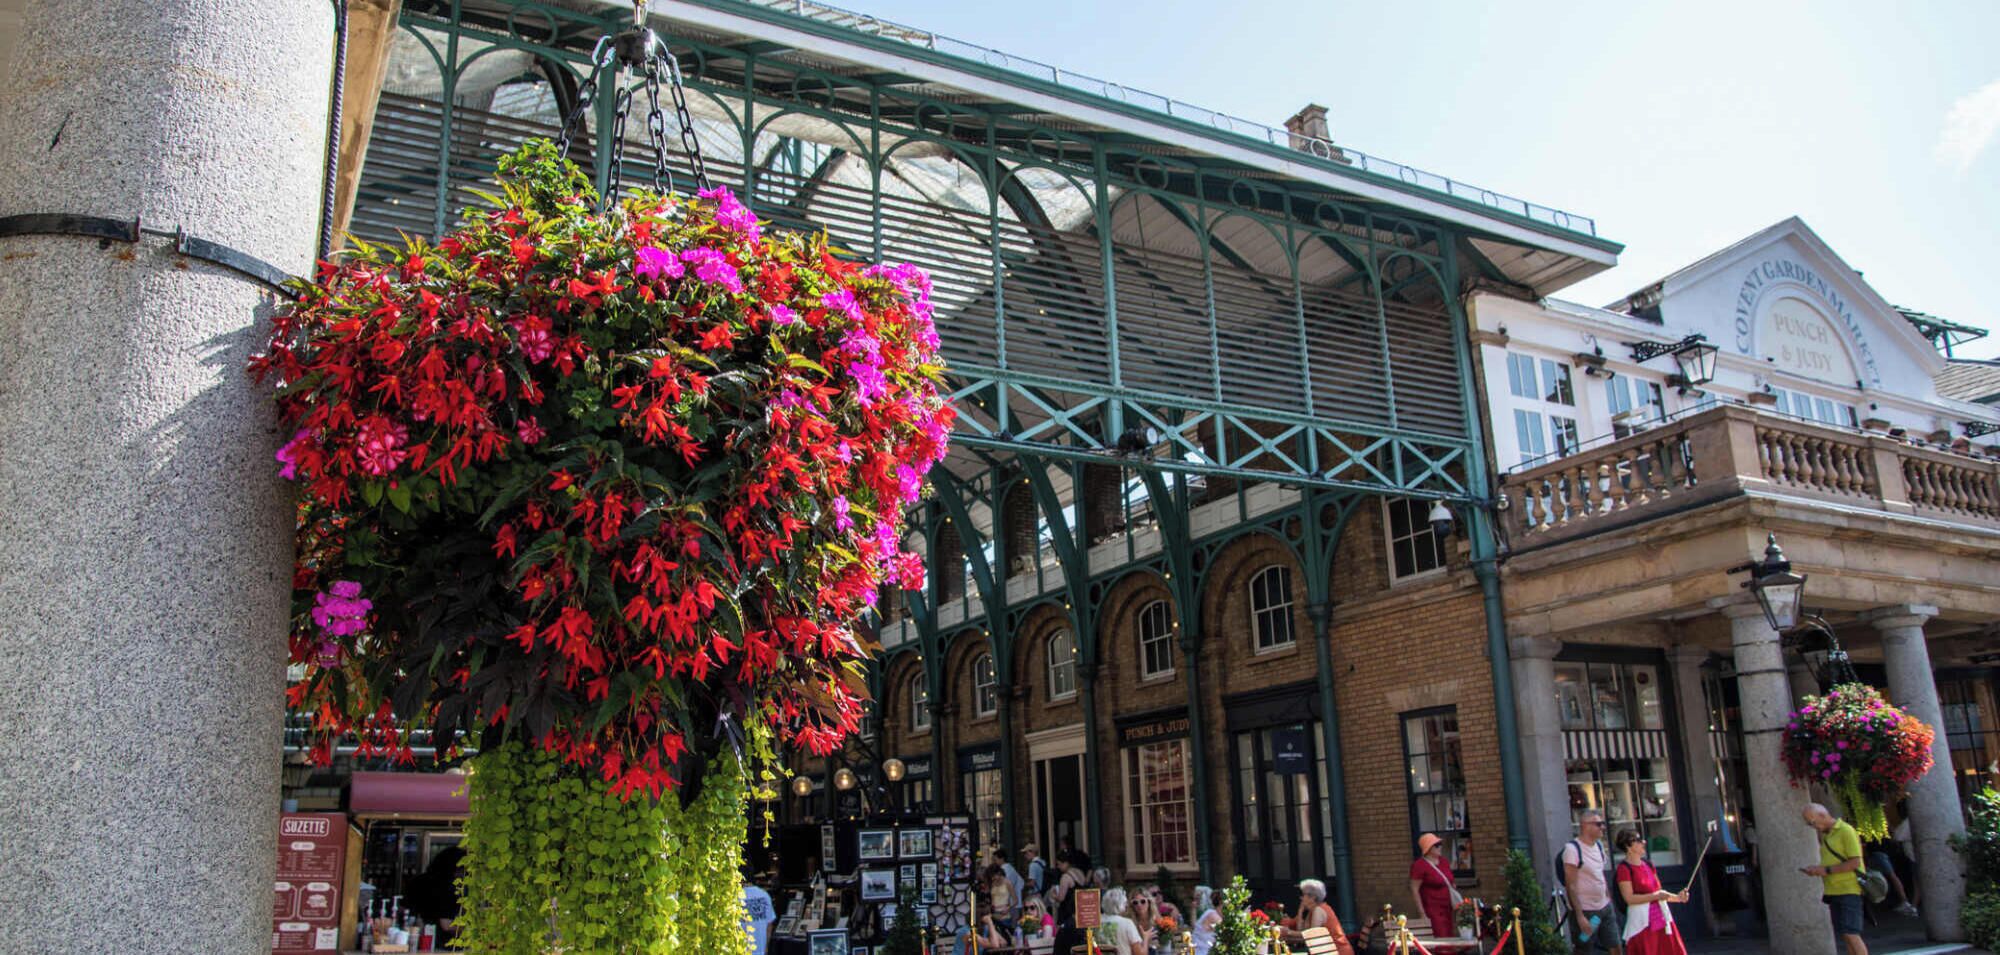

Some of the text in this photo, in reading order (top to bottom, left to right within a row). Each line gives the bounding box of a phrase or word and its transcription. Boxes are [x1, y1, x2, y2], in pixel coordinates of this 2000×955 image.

[1736, 259, 1881, 384] COVENT GARDEN MARKET
[1774, 313, 1828, 344] PUNCH
[1781, 344, 1833, 373] & JUDY
[1125, 718, 1190, 741] PUNCH & JUDY
[284, 820, 325, 833] SUZETTE
